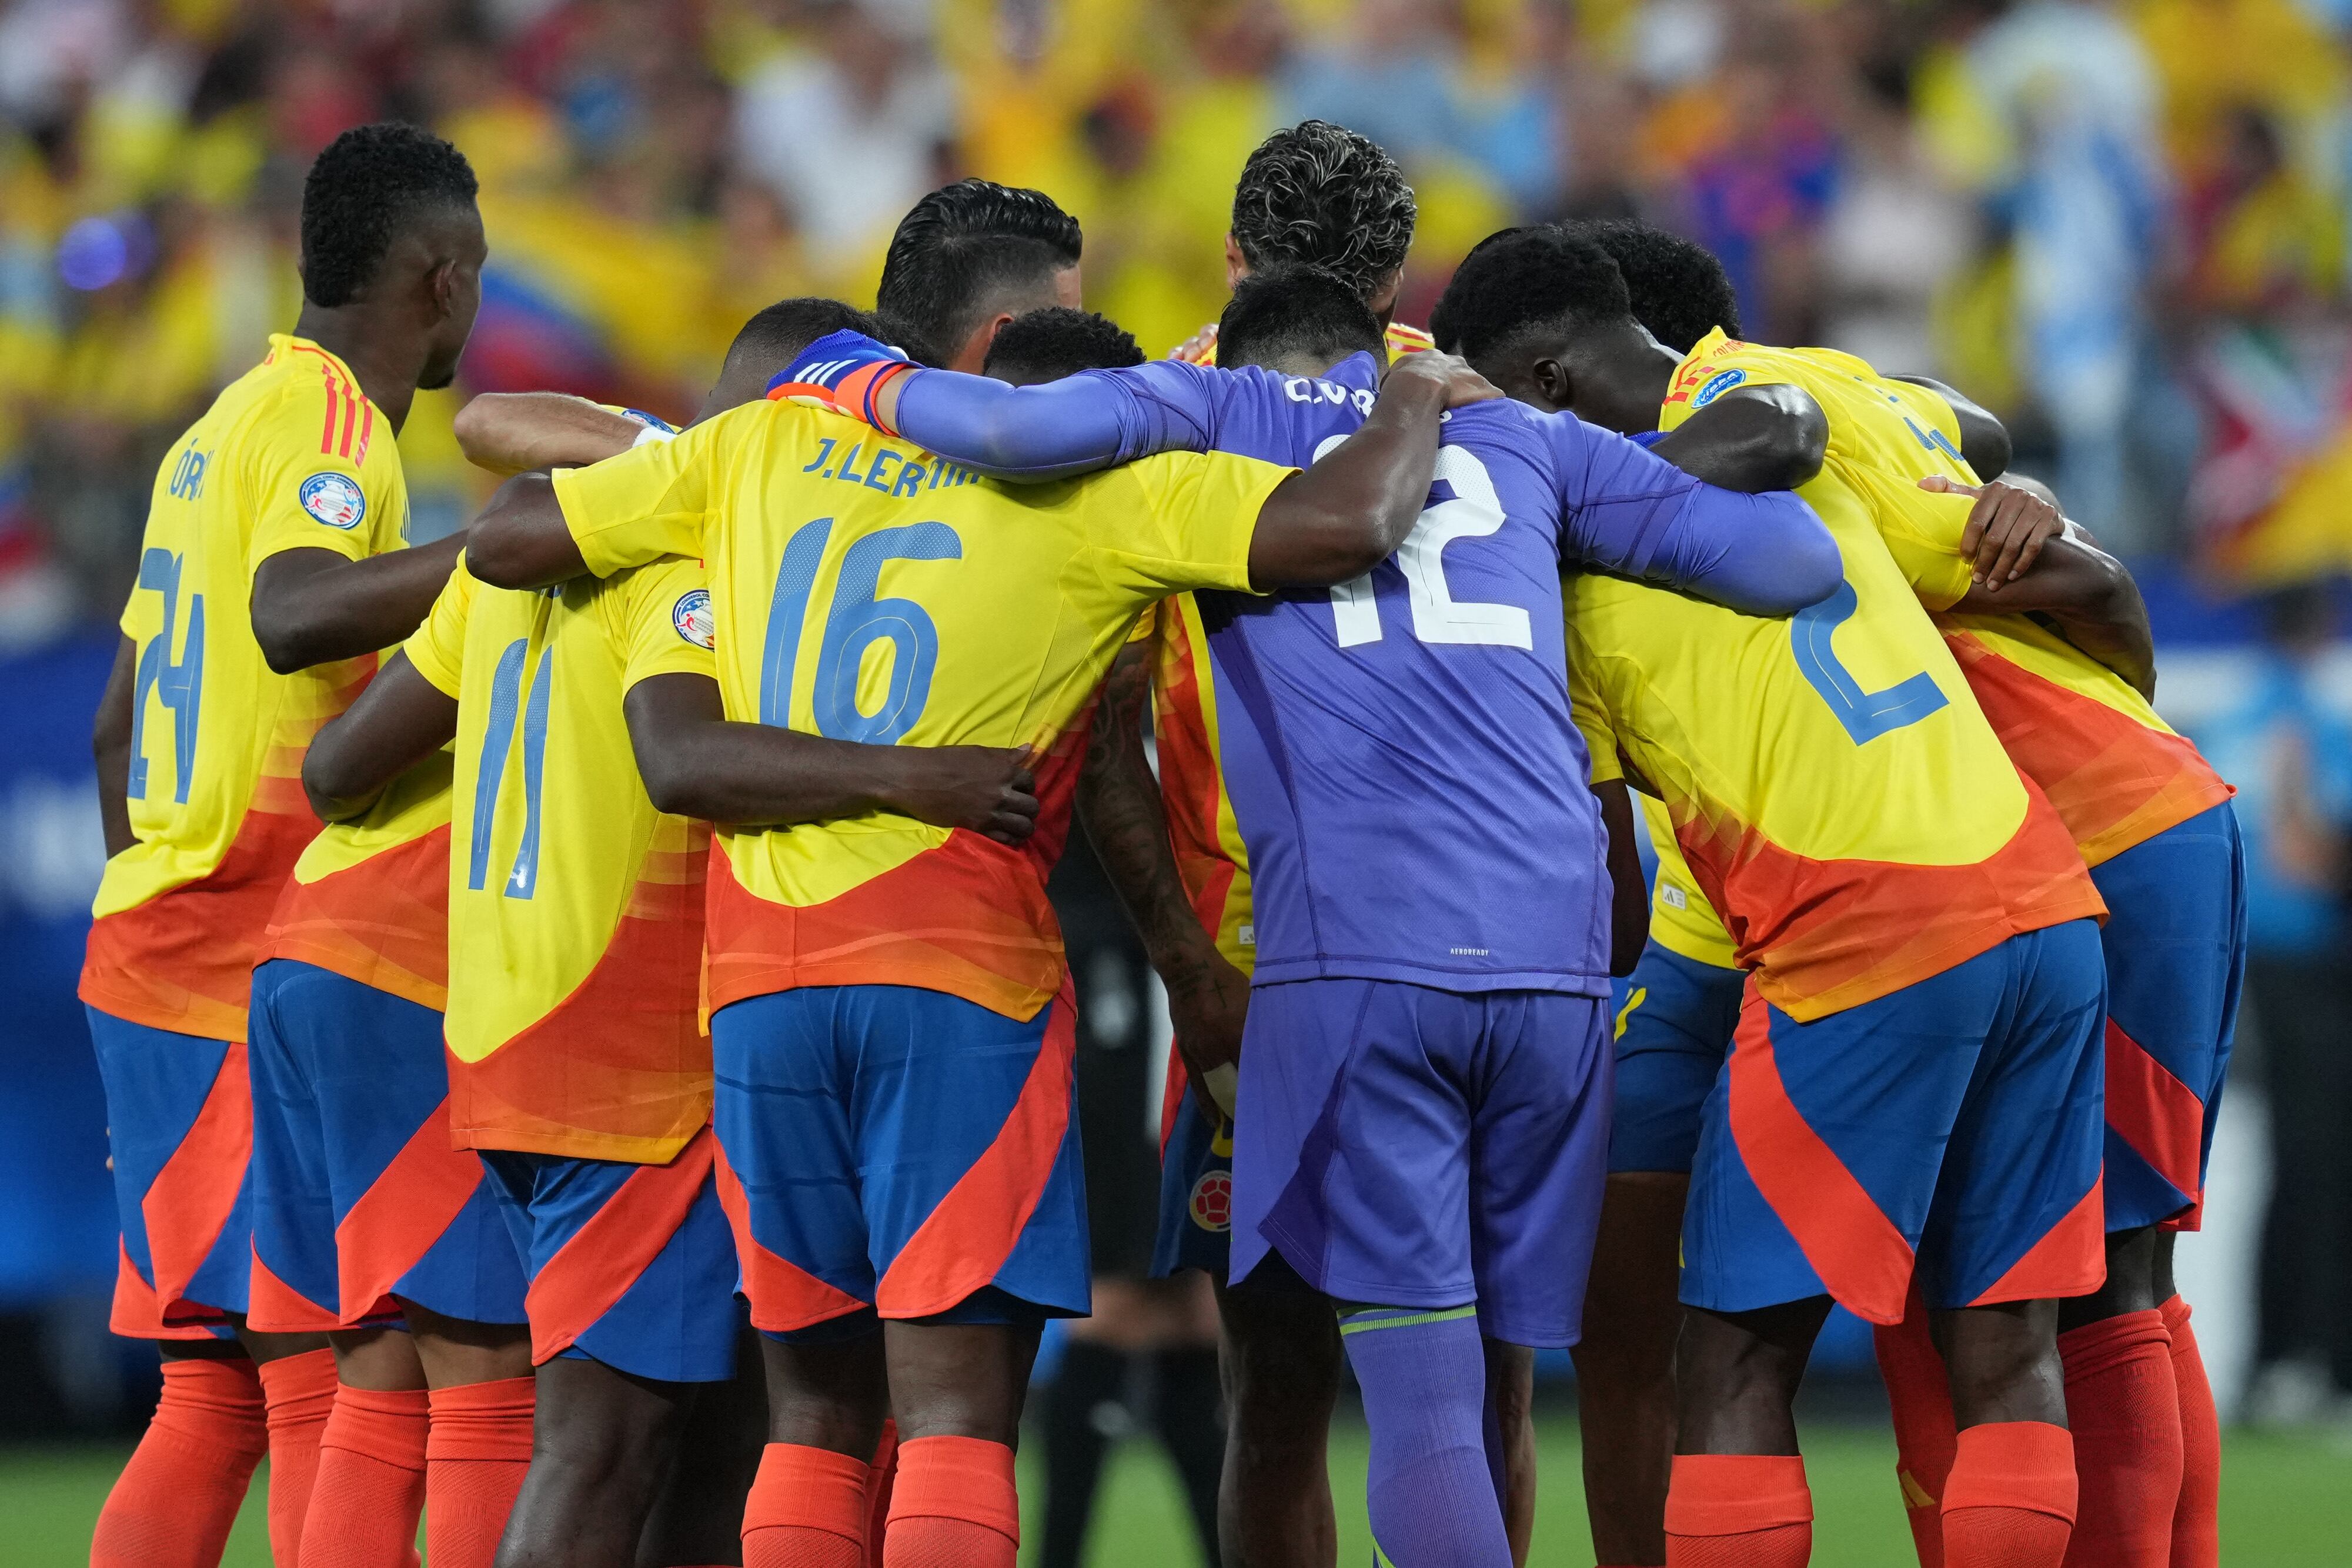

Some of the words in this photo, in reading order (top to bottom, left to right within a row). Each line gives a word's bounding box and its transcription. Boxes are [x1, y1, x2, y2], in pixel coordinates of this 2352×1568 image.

[126, 547, 205, 804] 24
[759, 517, 963, 746] 16
[467, 637, 553, 900] 11
[1450, 948, 1489, 957] AEROREADY
